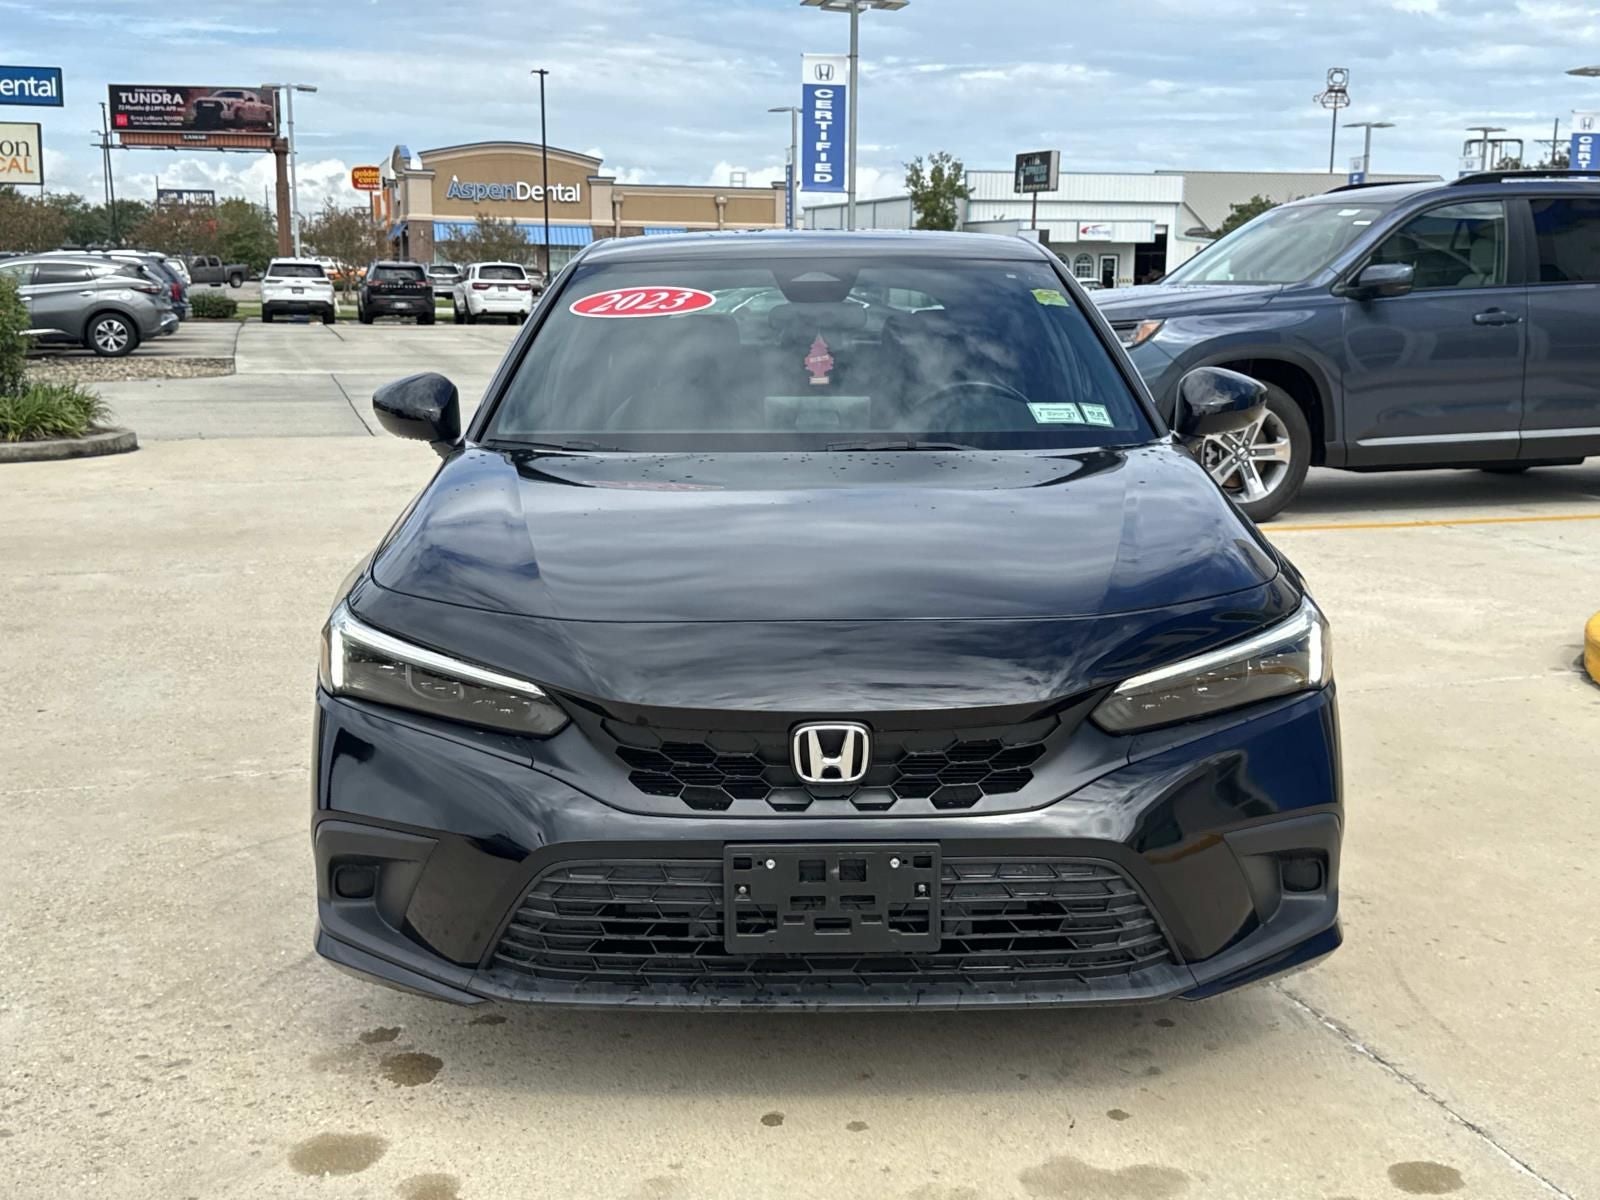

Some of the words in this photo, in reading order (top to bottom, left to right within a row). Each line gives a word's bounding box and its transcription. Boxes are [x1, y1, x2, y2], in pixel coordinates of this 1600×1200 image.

[0, 76, 57, 97] ental
[119, 92, 184, 105] TUNDRA
[814, 89, 834, 183] CERTIFIED
[0, 139, 32, 157] on
[447, 175, 581, 203] AspenDental
[587, 290, 694, 313] 2023
